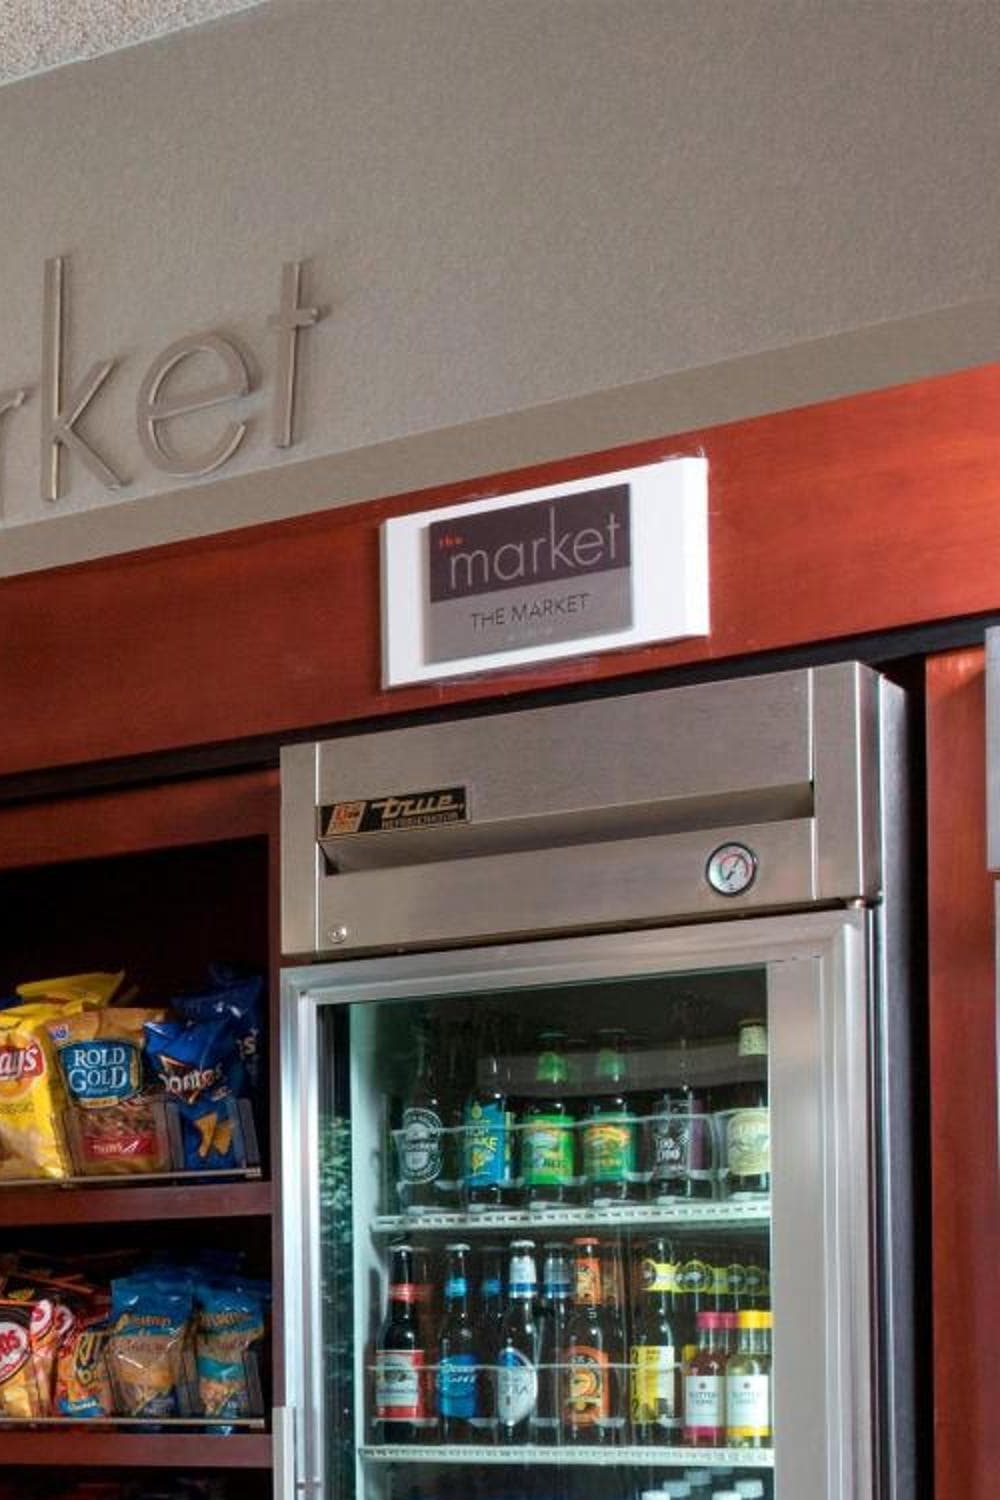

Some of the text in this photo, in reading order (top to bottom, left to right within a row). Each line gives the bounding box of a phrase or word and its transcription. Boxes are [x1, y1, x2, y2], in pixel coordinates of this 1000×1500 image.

[449, 506, 620, 589] market
[471, 593, 590, 630] THE MARKET
[74, 1047, 125, 1067] ROLD
[69, 1066, 127, 1092] GOLD
